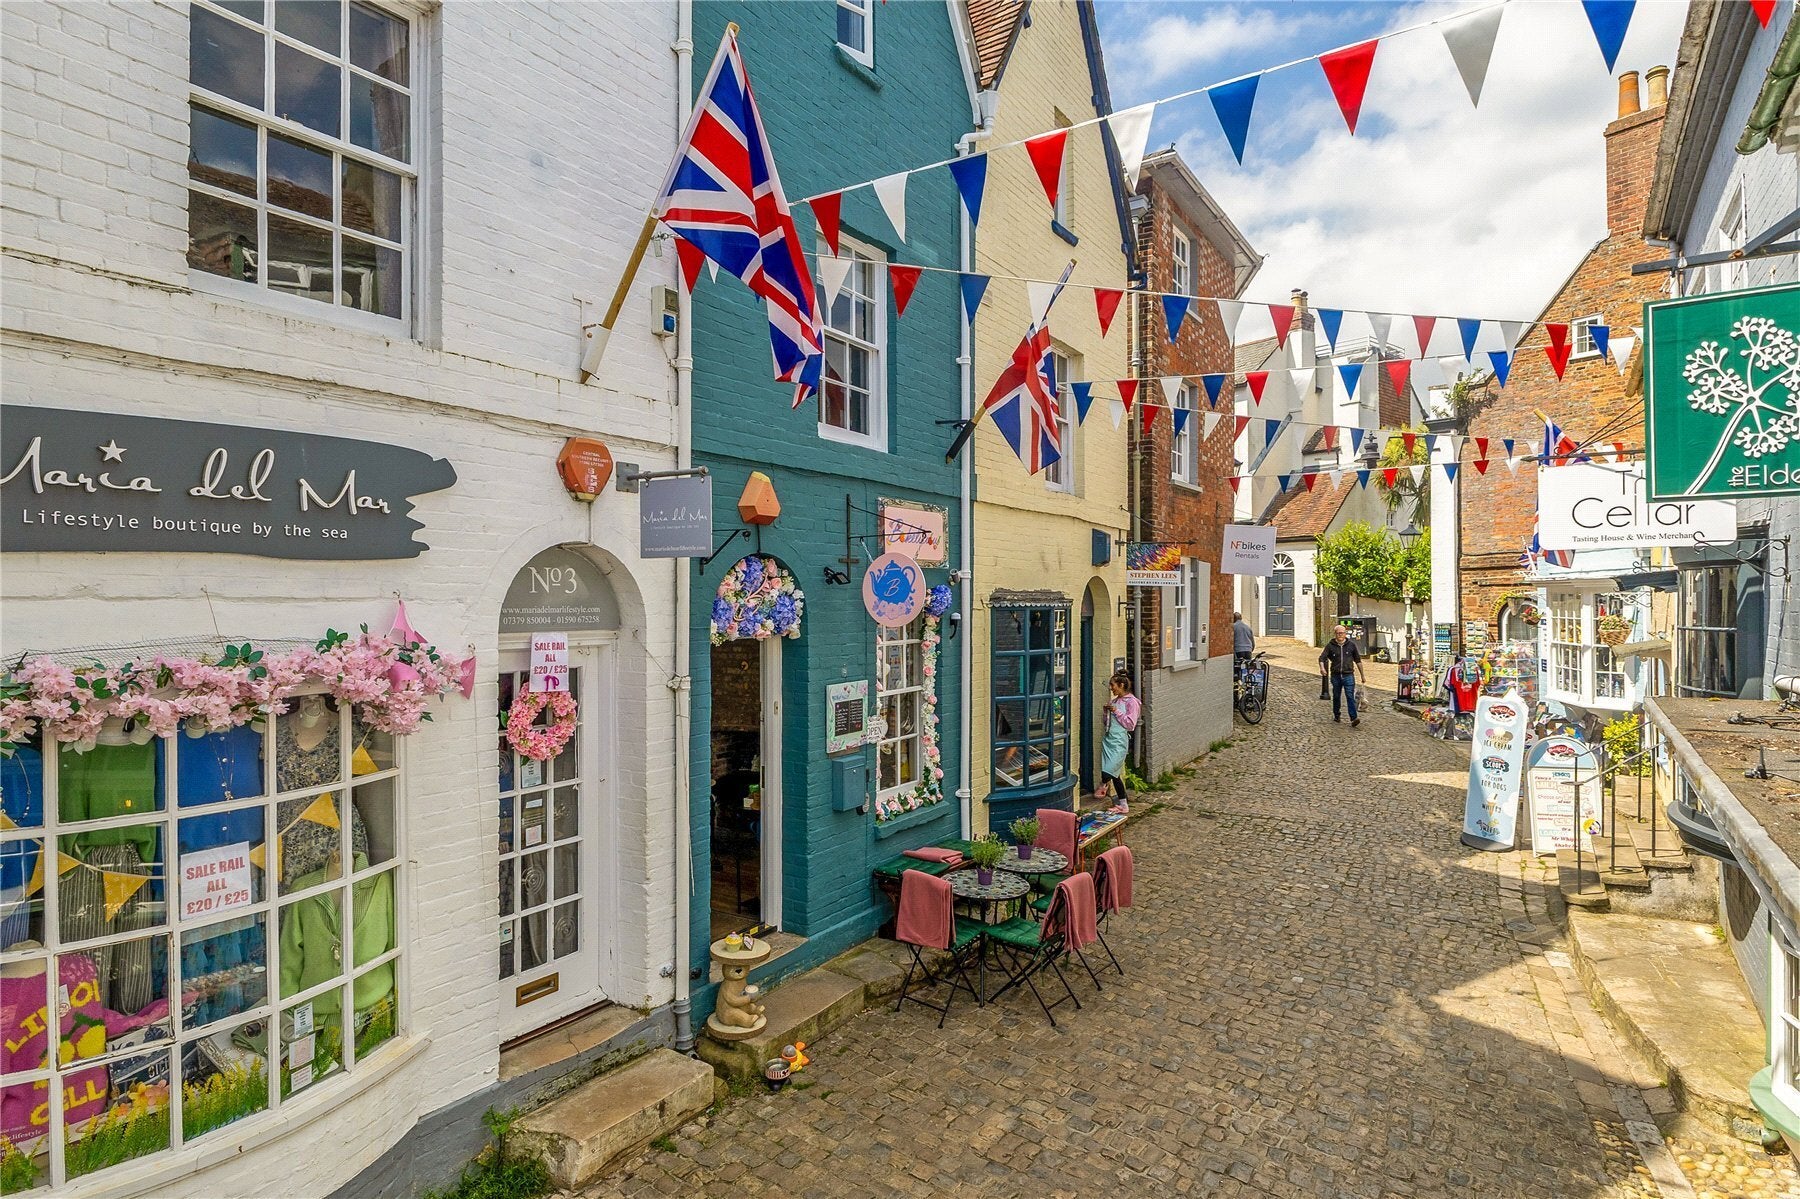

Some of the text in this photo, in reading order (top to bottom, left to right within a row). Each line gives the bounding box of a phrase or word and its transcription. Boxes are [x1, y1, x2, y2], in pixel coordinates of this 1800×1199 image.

[189, 447, 275, 501] del
[299, 469, 391, 515] Mar
[1727, 465, 1744, 487] the
[643, 506, 708, 524] Maria del Mar
[1572, 495, 1695, 529] Cellar
[23, 509, 348, 539] Lifestyle boutique by the sea
[1230, 540, 1267, 551] NFbikes
[1572, 535, 1599, 543] Tasting
[1600, 534, 1625, 542] House
[1636, 533, 1657, 541] Wine
[1659, 532, 1697, 540] Merchan
[884, 578, 900, 597] B
[501, 606, 600, 615] www.mariadelmarlifestyle.com
[503, 616, 525, 625] 07379
[526, 615, 551, 624] 850004
[556, 615, 577, 624] 01590
[577, 615, 600, 623] 675258
[534, 641, 566, 651] SALE RAIL
[544, 653, 556, 662] ALL
[534, 665, 548, 674] £20
[554, 664, 568, 674] £25
[1492, 782, 1507, 792] DOGS
[186, 856, 246, 880] SALE RAIL
[206, 877, 228, 894] ALL
[186, 889, 249, 915] £20 / £25
